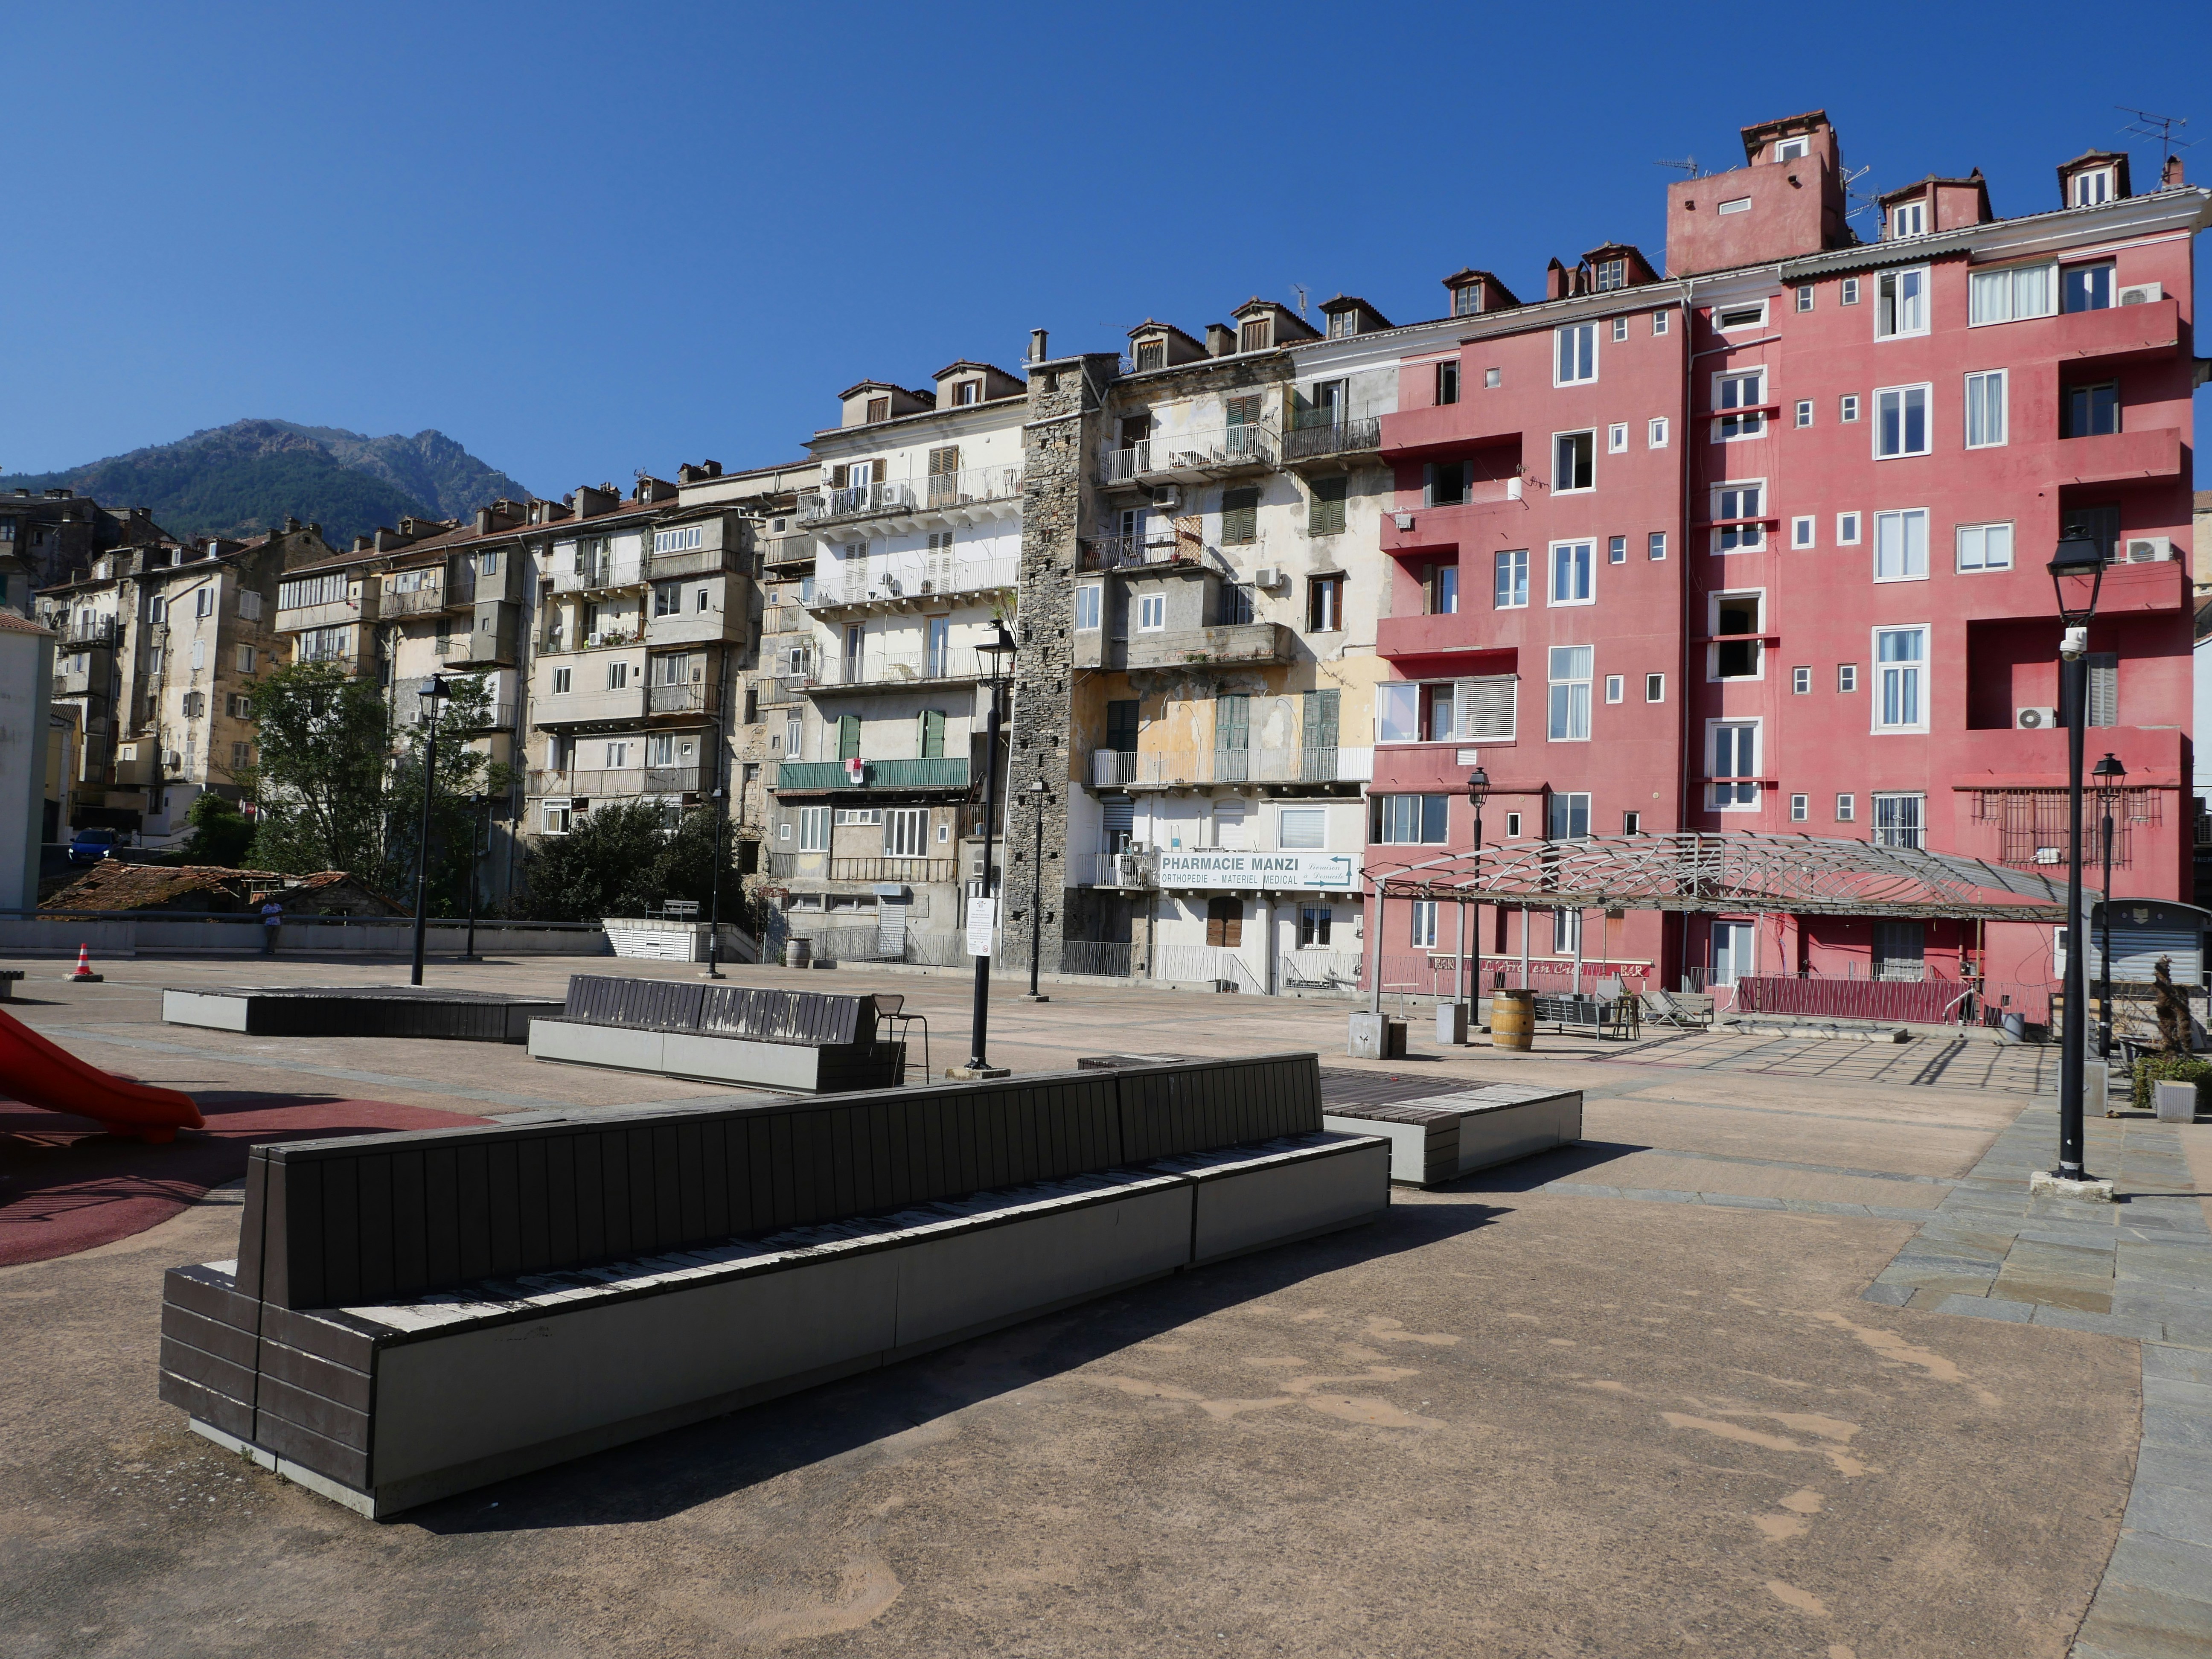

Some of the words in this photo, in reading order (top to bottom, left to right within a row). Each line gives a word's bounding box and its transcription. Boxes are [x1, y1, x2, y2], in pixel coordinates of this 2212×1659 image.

[1162, 857, 1244, 870] PHARMACIE
[1252, 858, 1298, 871] MANZI
[1162, 873, 1208, 883] ORTHOPEDIE
[1222, 875, 1257, 884] MATERIEL
[1264, 875, 1298, 885] MEDICAL
[1435, 958, 1455, 969] BAR
[1533, 965, 1550, 973] en
[1621, 965, 1643, 977] BAR
